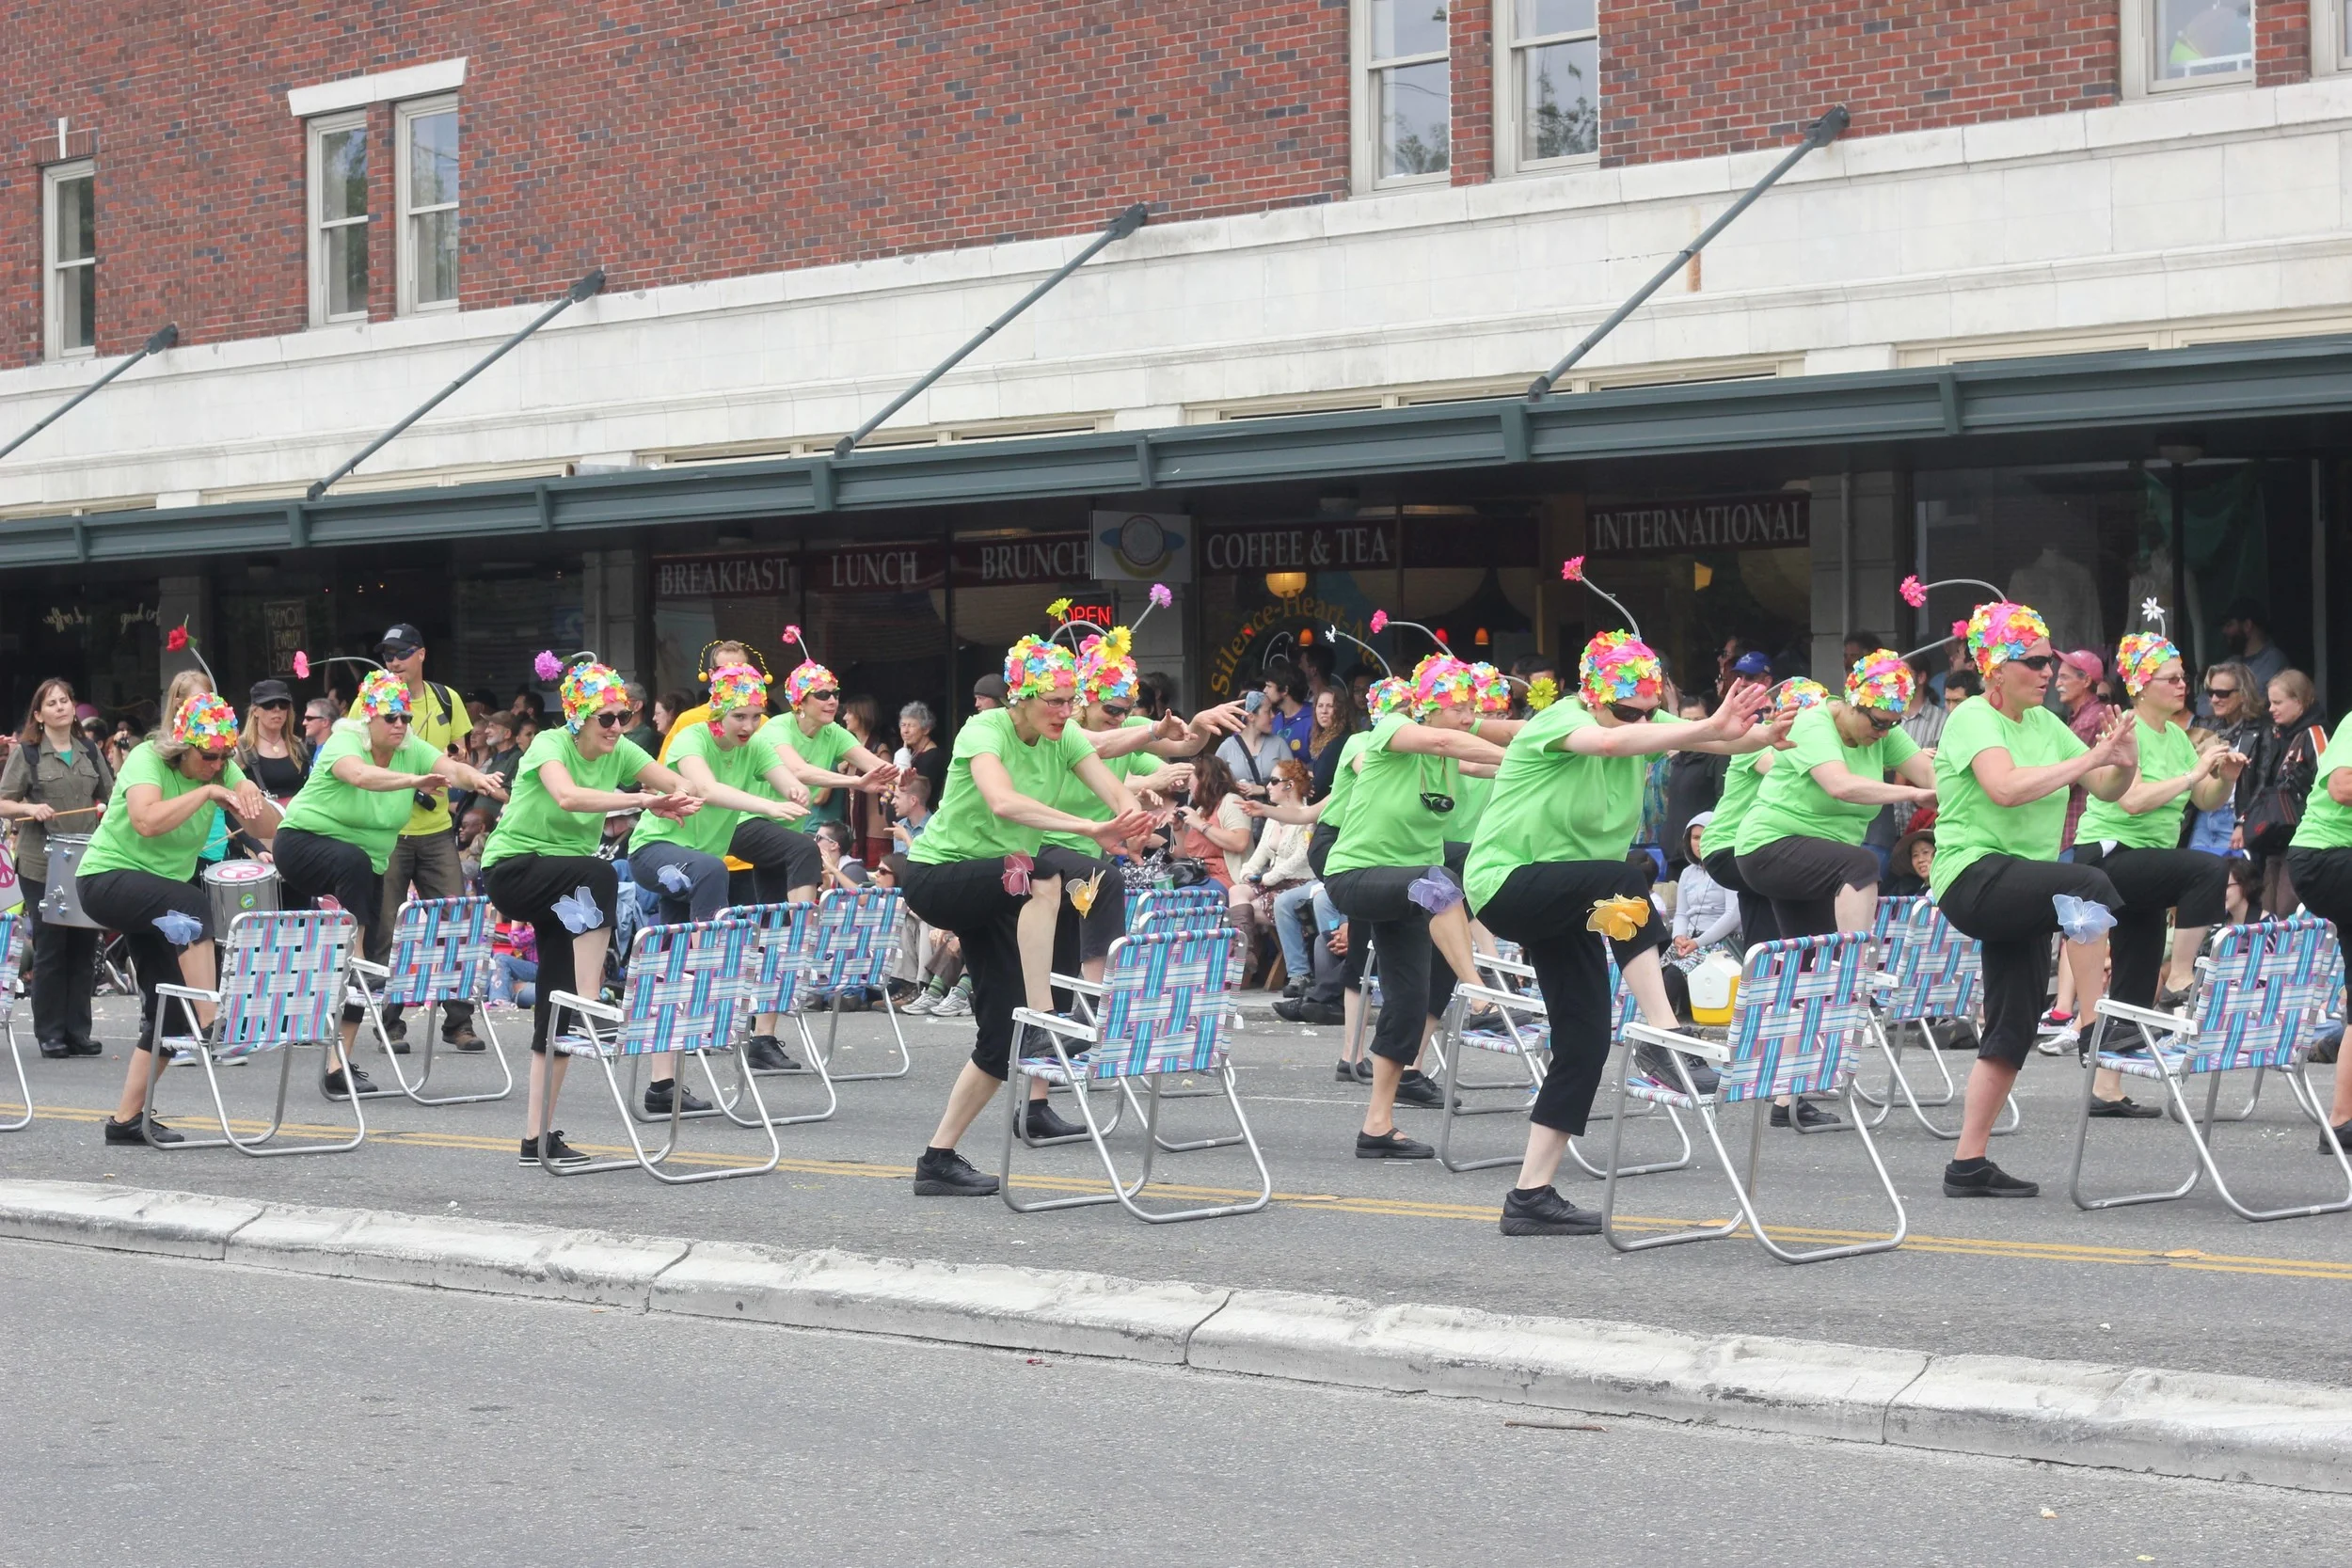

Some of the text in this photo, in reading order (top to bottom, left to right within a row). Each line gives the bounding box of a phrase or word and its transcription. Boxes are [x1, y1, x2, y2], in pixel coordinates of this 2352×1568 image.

[1594, 501, 1805, 550] INTERNATIONAL
[981, 542, 1090, 579] BRUNCH
[1207, 527, 1389, 569] COFFEE & TEA
[660, 558, 788, 594] BREAKFAST
[832, 551, 917, 587] LUNCH
